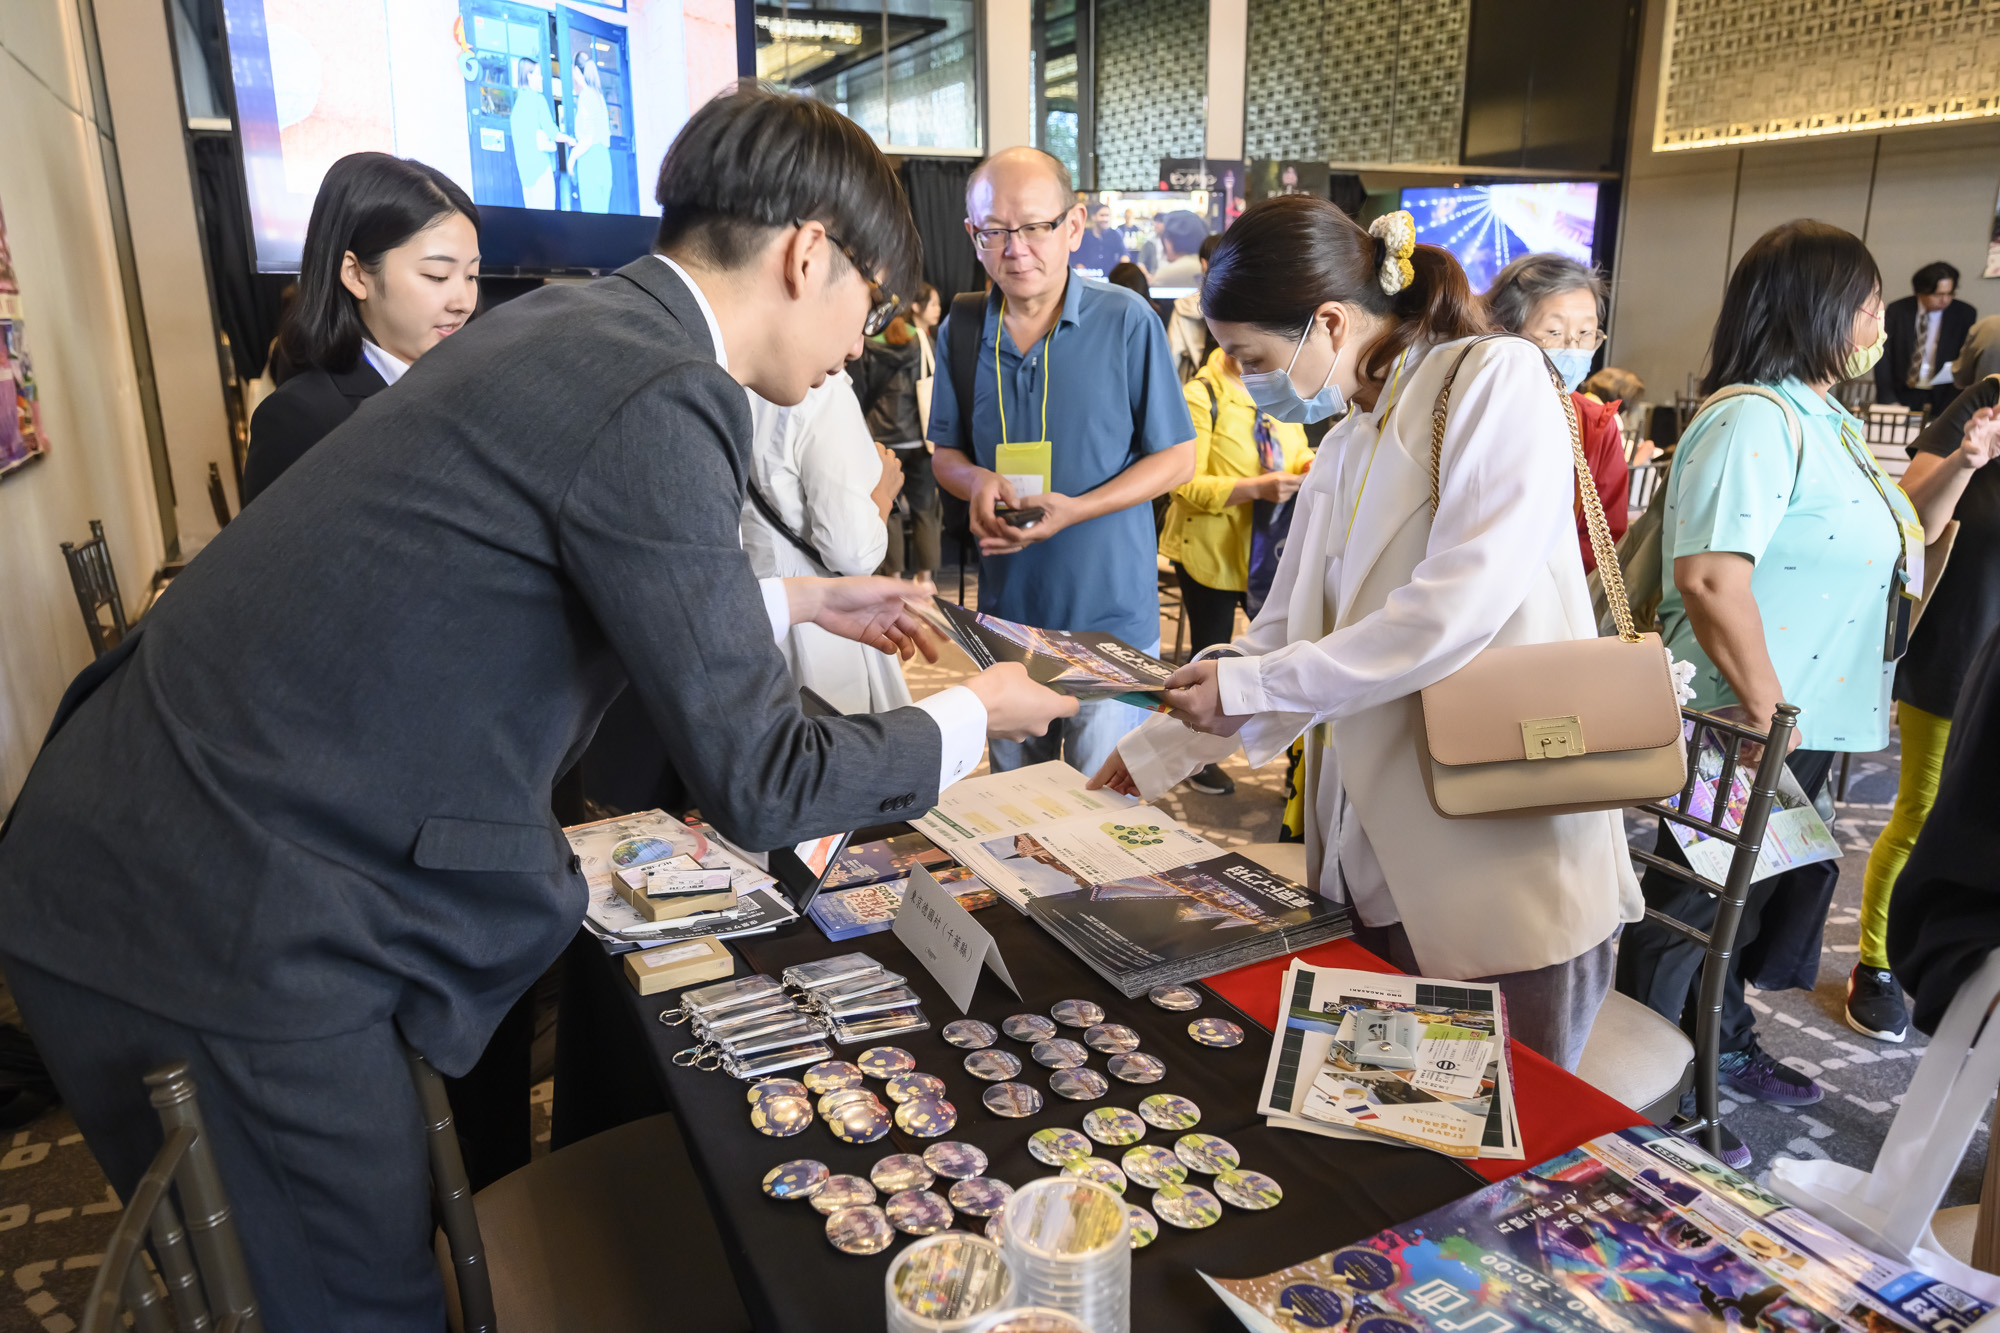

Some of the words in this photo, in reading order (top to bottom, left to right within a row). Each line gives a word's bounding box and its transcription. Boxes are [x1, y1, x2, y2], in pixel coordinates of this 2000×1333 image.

[1225, 865, 1315, 908] 東京ドイツ村
[1349, 988, 1385, 996] NAGASAKI
[1402, 1115, 1466, 1133] nagasaki
[1421, 1126, 1464, 1140] travel
[1655, 1146, 1694, 1170] ACCESS
[1480, 1254, 1550, 1292] 20:00
